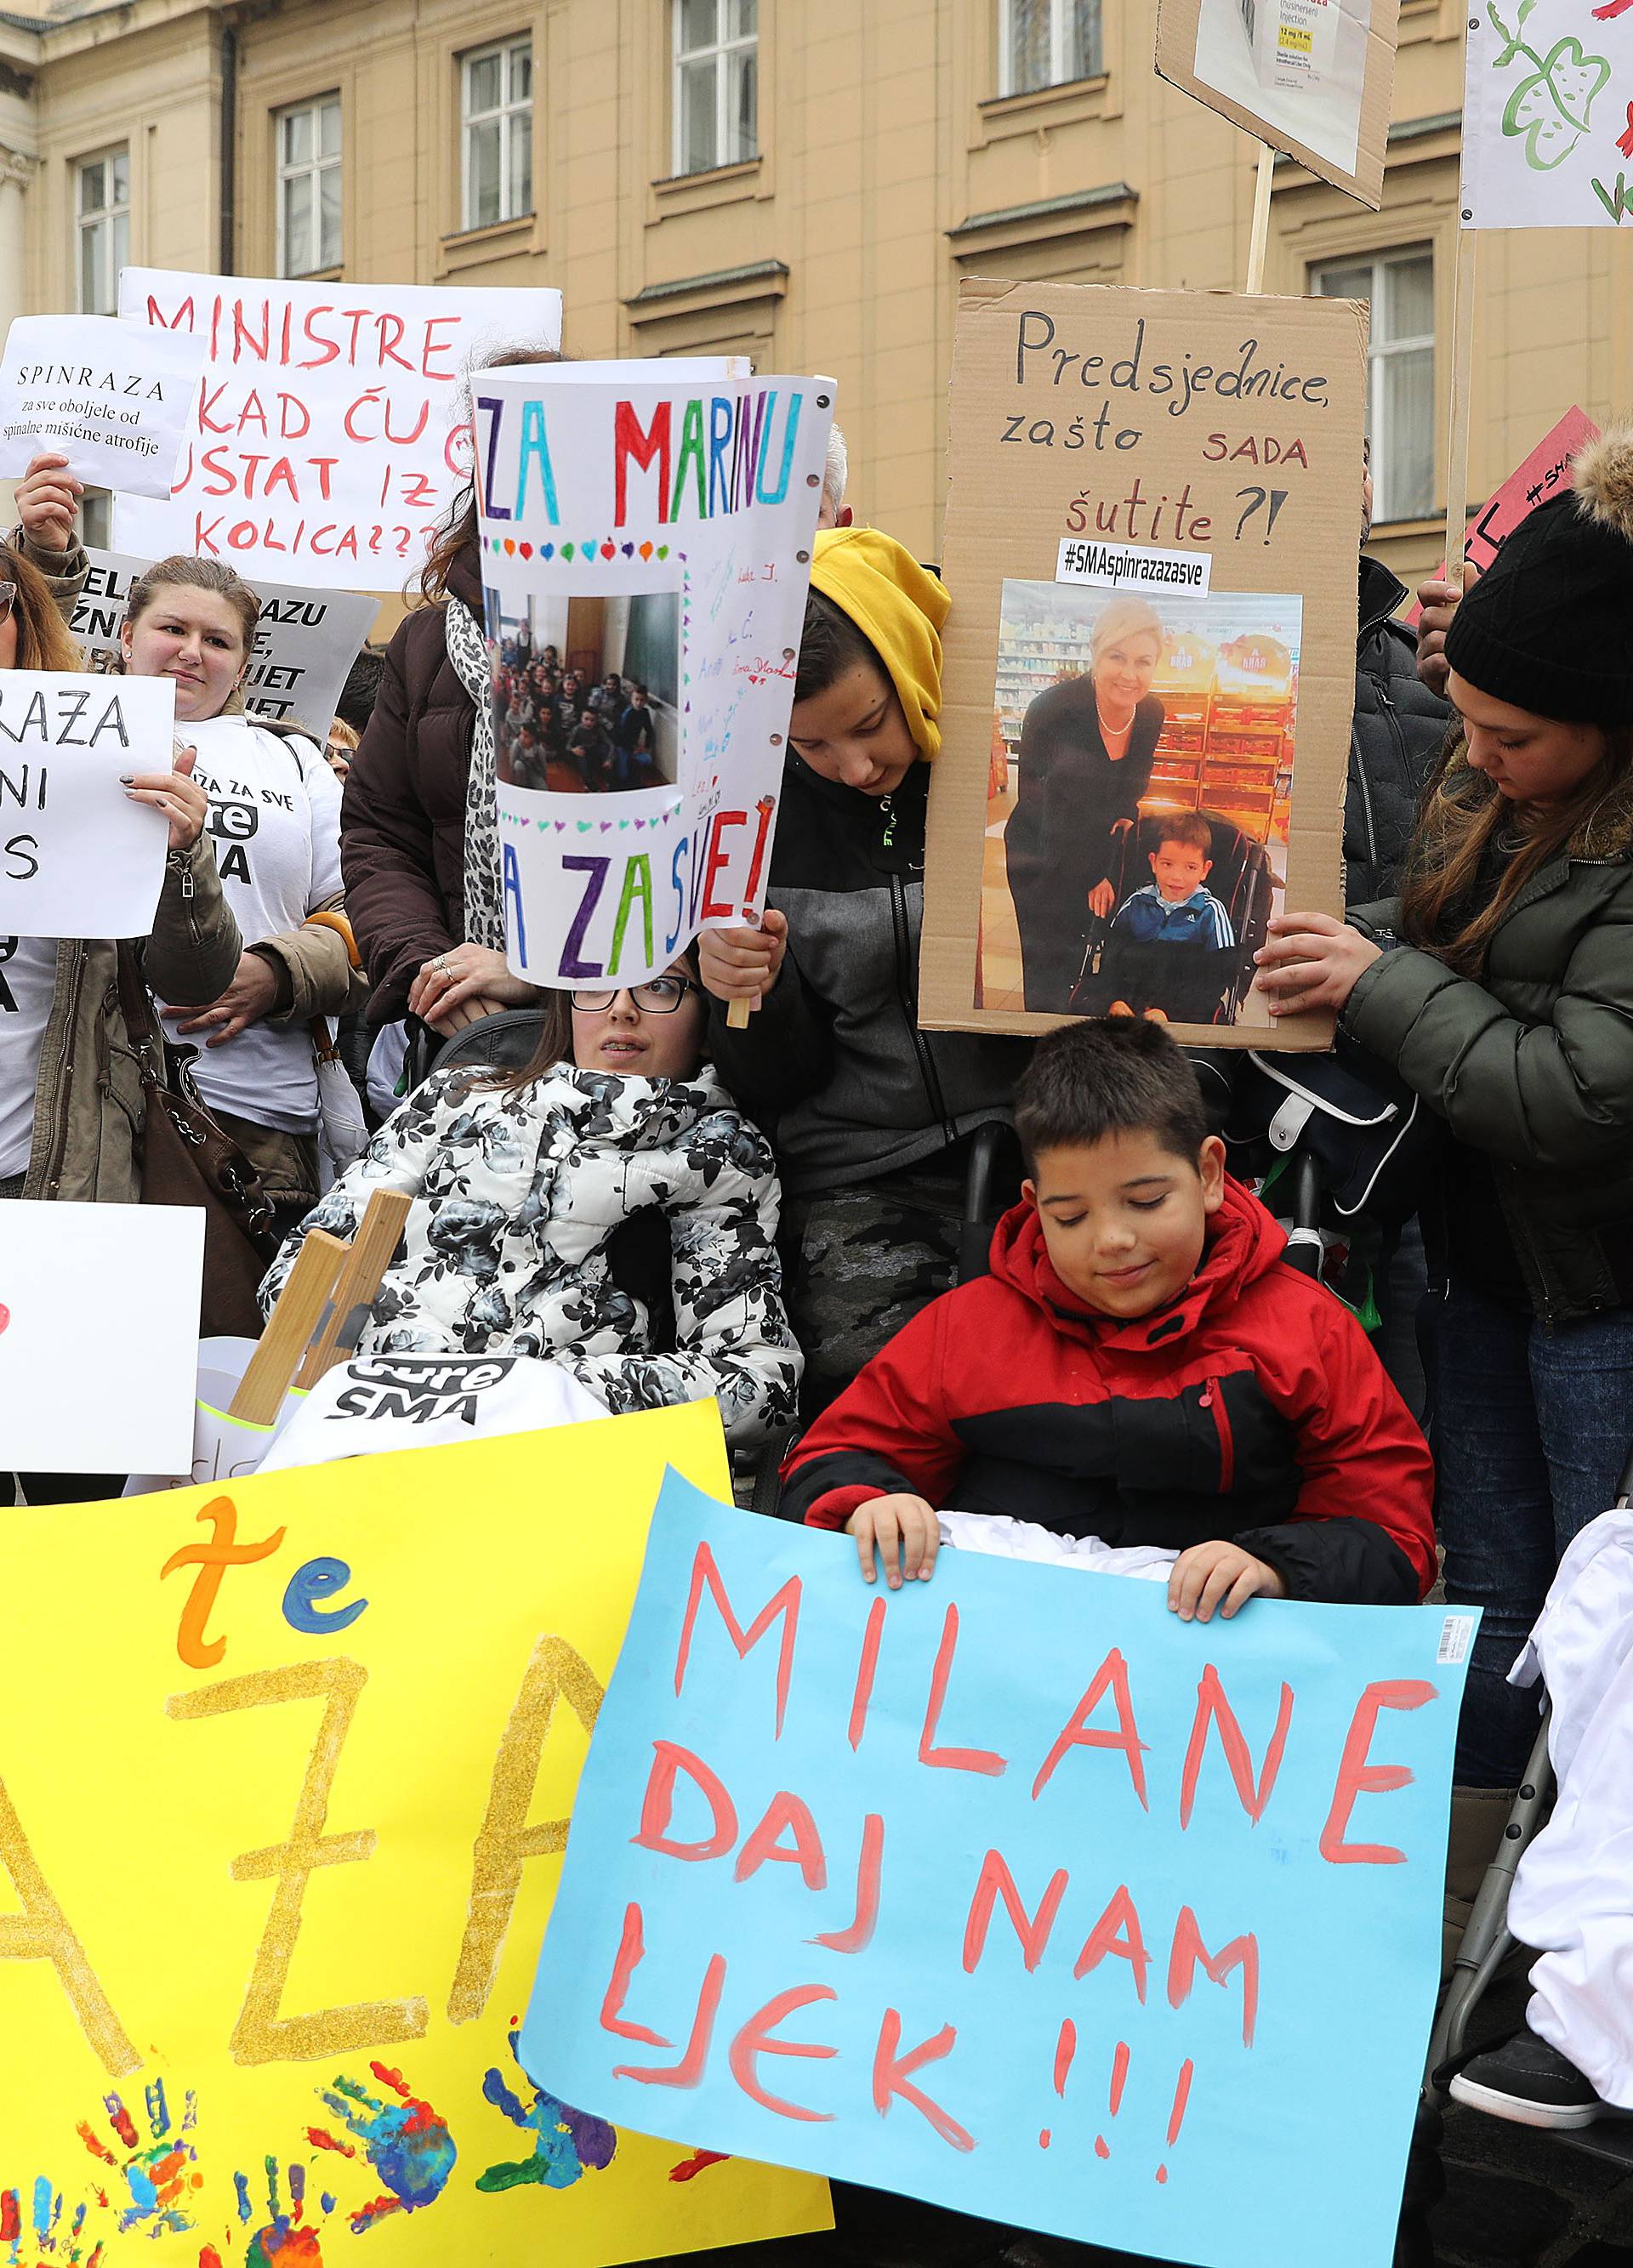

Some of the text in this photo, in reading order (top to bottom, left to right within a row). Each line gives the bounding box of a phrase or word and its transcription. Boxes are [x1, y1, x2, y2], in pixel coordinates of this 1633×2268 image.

[1280, 10, 1307, 26] Injection
[1281, 27, 1288, 36] 12
[147, 294, 462, 381] MINISTRE
[1016, 310, 1329, 417] Predsjednice,
[17, 365, 164, 401] SPINRAZA
[22, 398, 140, 425] za sve oboljele od
[198, 376, 430, 445] KAD ĆU
[3, 420, 159, 457] spinalne mišićne atrofije
[477, 390, 803, 527] ZA MARINU
[1000, 400, 1308, 469] zašto SADA
[381, 463, 439, 509] IZ
[1066, 477, 1289, 547] šutite ?!
[1064, 543, 1203, 587] #SMAspinrazazasve
[230, 779, 254, 799] ZA
[261, 789, 294, 812] SVE
[558, 853, 653, 979] ZA
[665, 799, 775, 954] SVE!
[324, 1386, 478, 1426] SMA
[161, 1495, 369, 1669] te
[674, 1540, 1441, 1865] MILANE
[629, 1740, 1260, 2049] DAJ NAM
